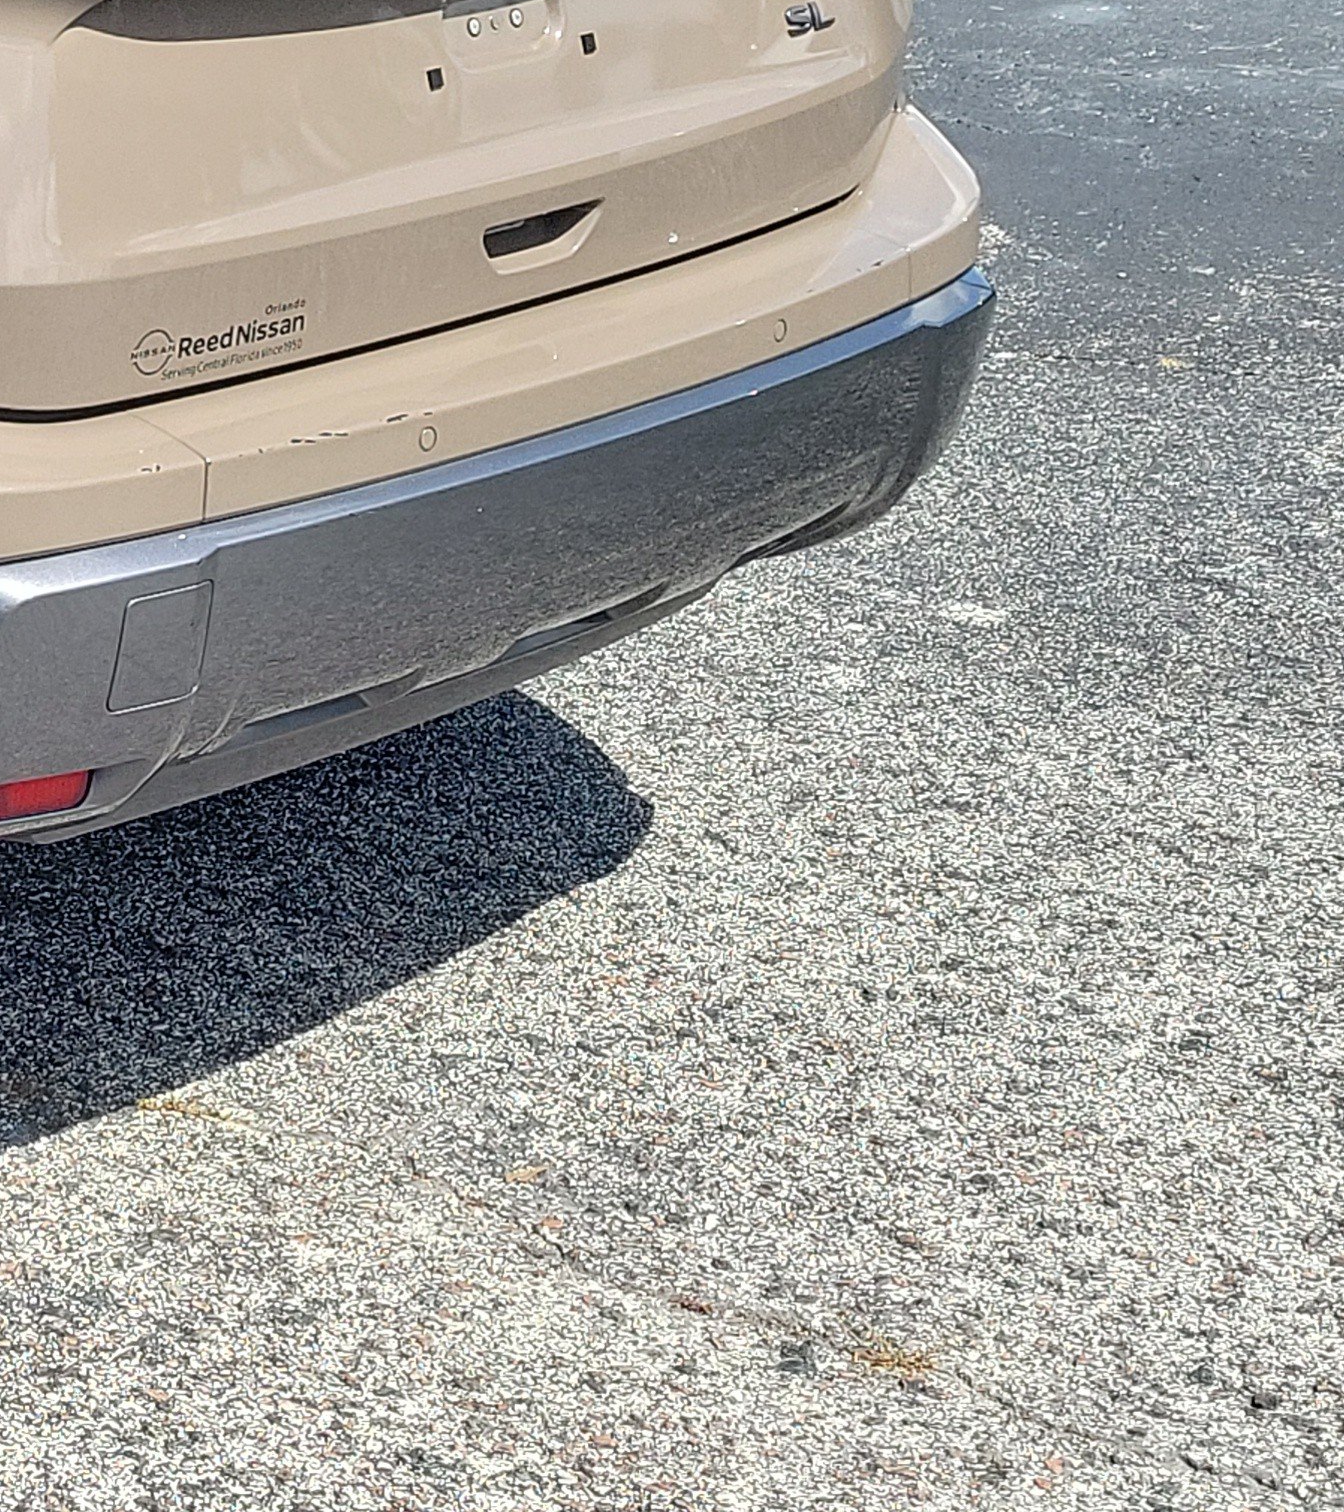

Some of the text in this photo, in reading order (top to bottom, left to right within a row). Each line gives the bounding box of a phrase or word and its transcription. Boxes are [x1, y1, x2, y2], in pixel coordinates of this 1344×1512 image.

[785, 1, 835, 38] SL
[265, 299, 306, 315] Orlando
[177, 315, 305, 359] Reed Nissan
[130, 345, 176, 360] NISSAN
[160, 366, 196, 380] Serving
[197, 354, 229, 373] Central
